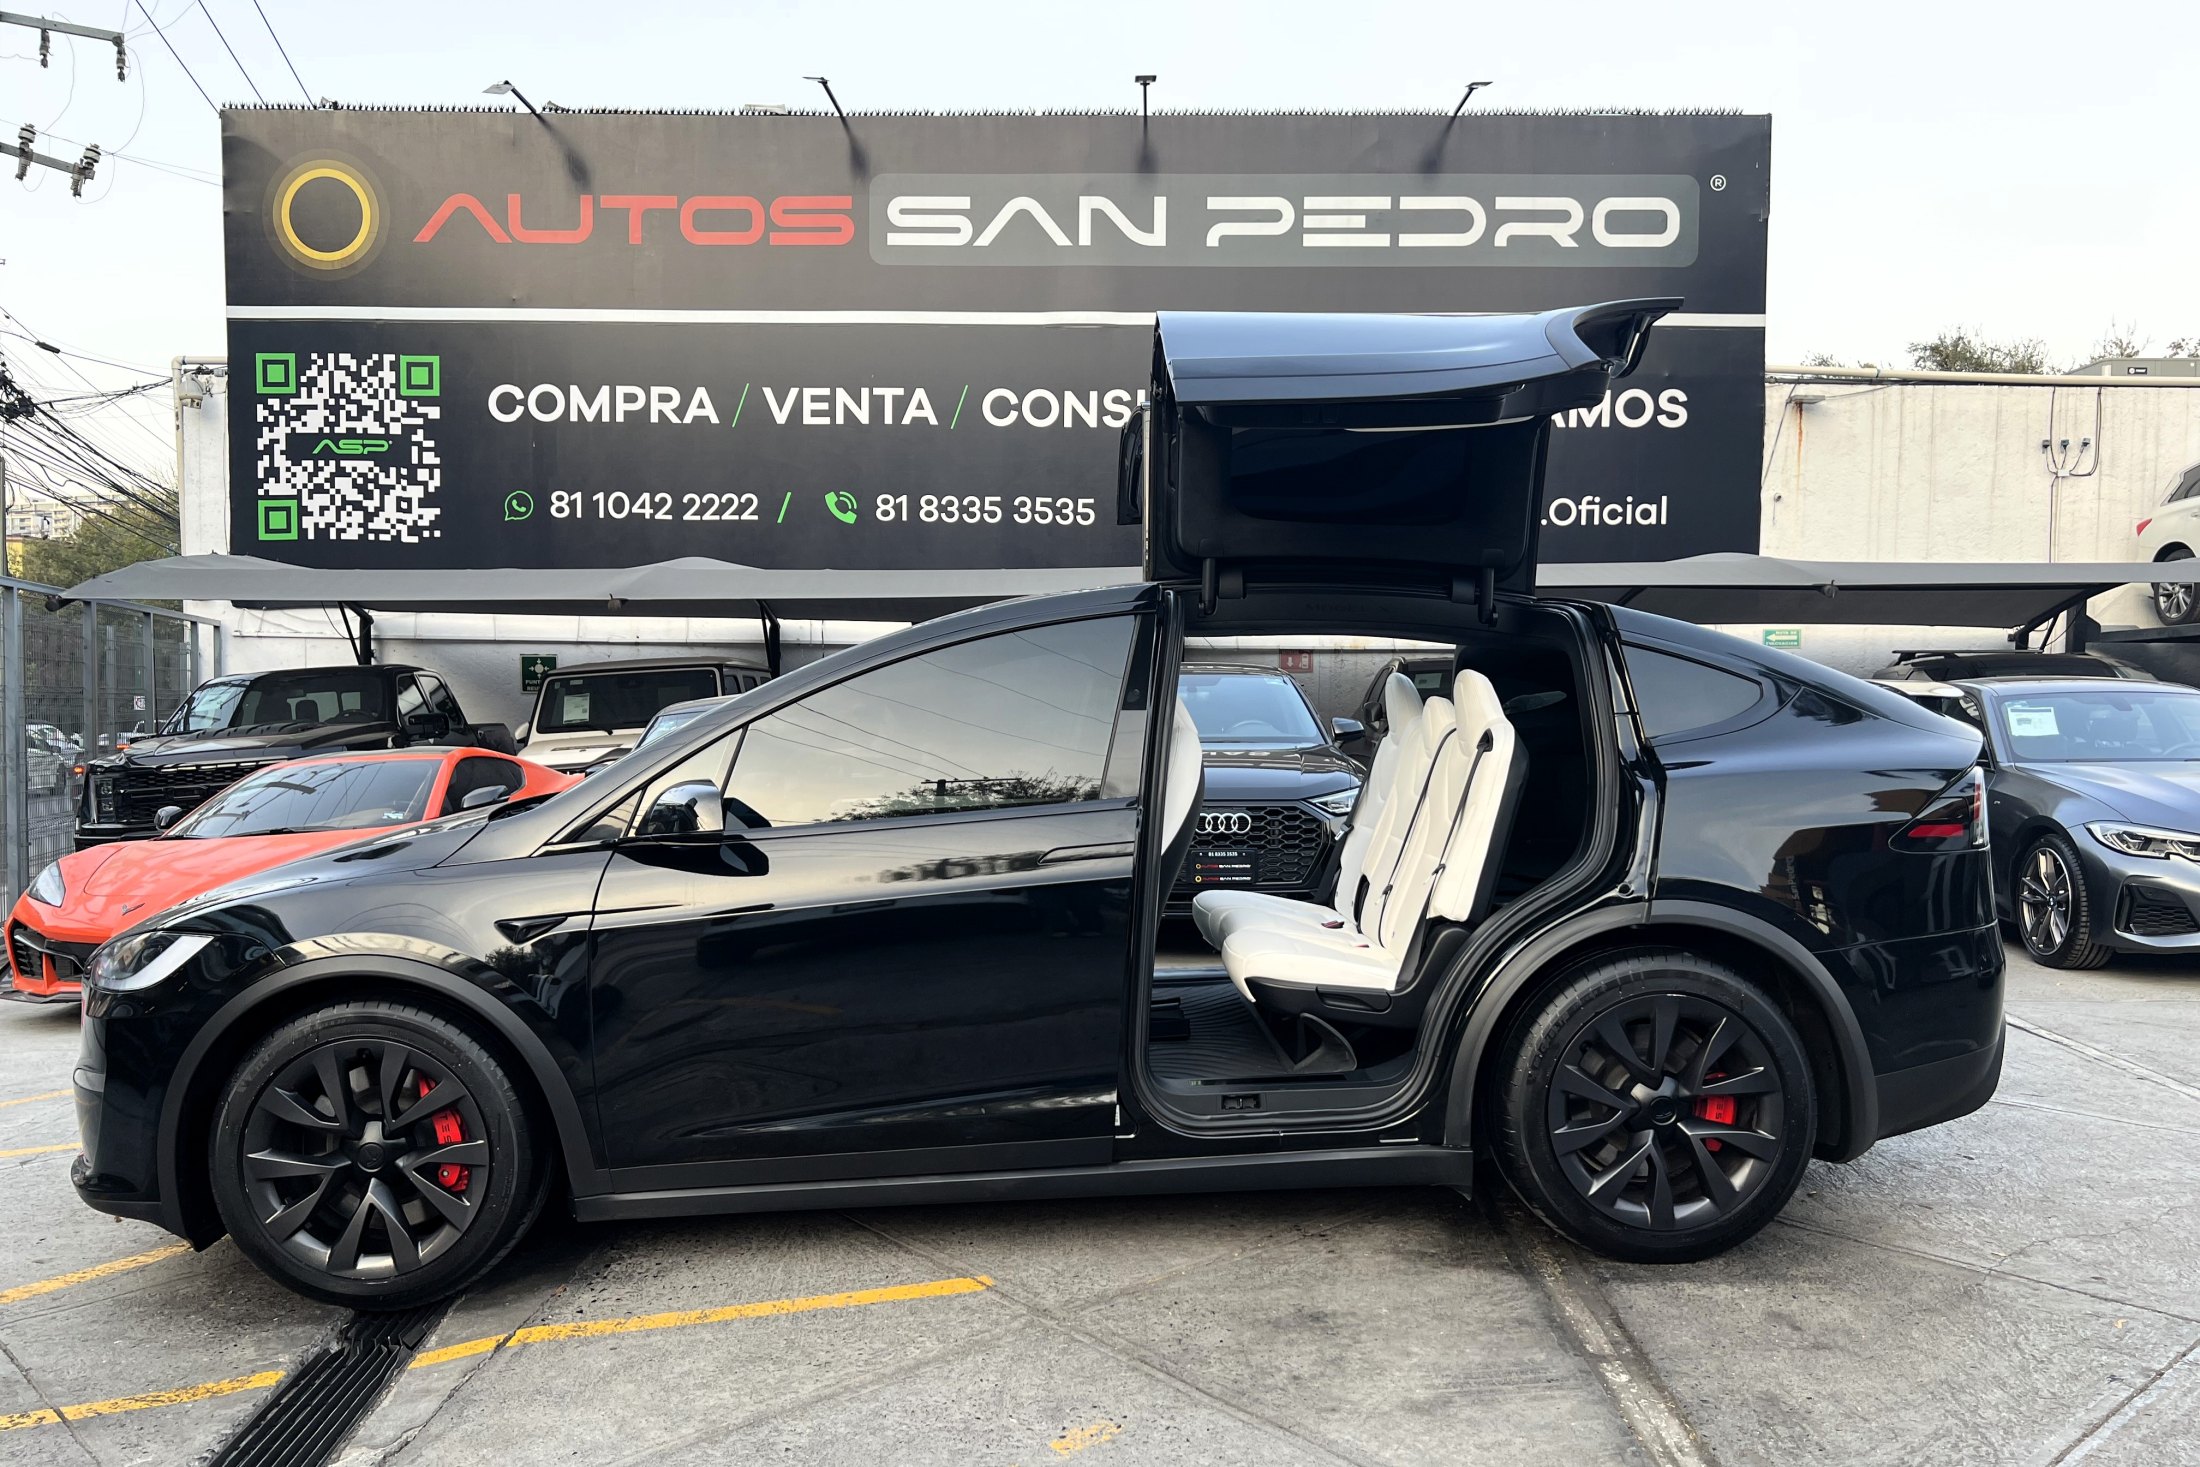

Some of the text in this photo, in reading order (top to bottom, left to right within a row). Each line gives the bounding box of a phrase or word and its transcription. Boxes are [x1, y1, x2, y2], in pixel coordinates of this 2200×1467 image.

[414, 193, 856, 246] AUTOS
[886, 195, 1168, 247] SAN
[1206, 195, 1681, 248] PEDRO
[487, 383, 721, 427] COMPRA
[761, 386, 940, 427] VENTA
[550, 490, 583, 520] 81
[592, 491, 674, 521] 1042
[682, 492, 759, 521] 2222
[875, 493, 908, 522] 81
[919, 494, 1004, 524] 8335
[1012, 495, 1096, 526] 3535
